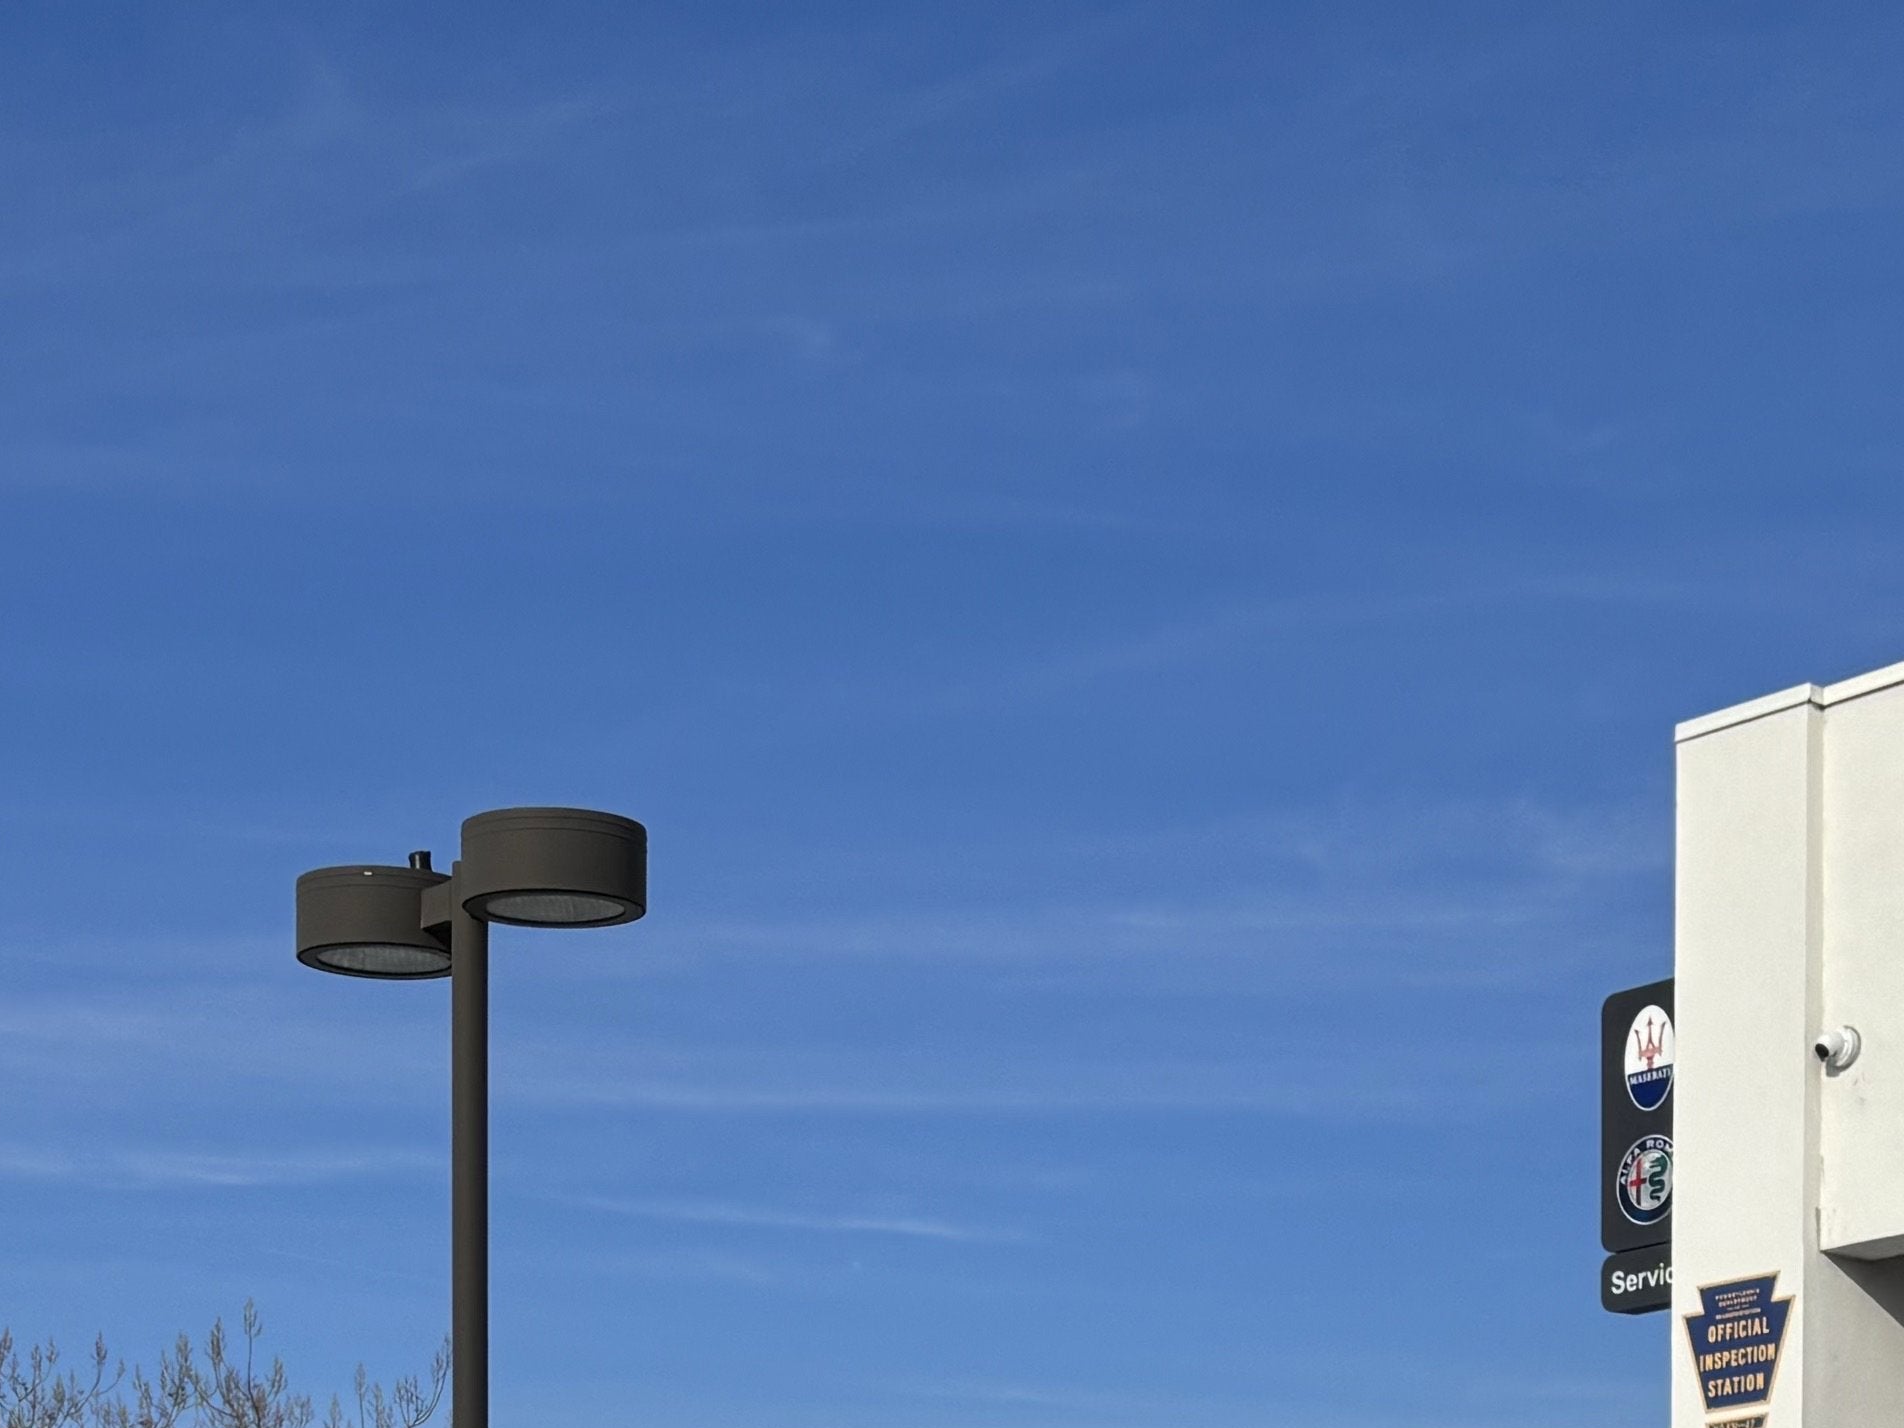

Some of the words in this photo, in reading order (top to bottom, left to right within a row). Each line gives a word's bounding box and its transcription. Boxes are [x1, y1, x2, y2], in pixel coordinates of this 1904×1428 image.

[1629, 1067, 1672, 1086] MASERATI
[1708, 1316, 1770, 1344] OFFICIAL
[1699, 1343, 1776, 1373] INSPECTION
[1708, 1372, 1765, 1398] STATION
